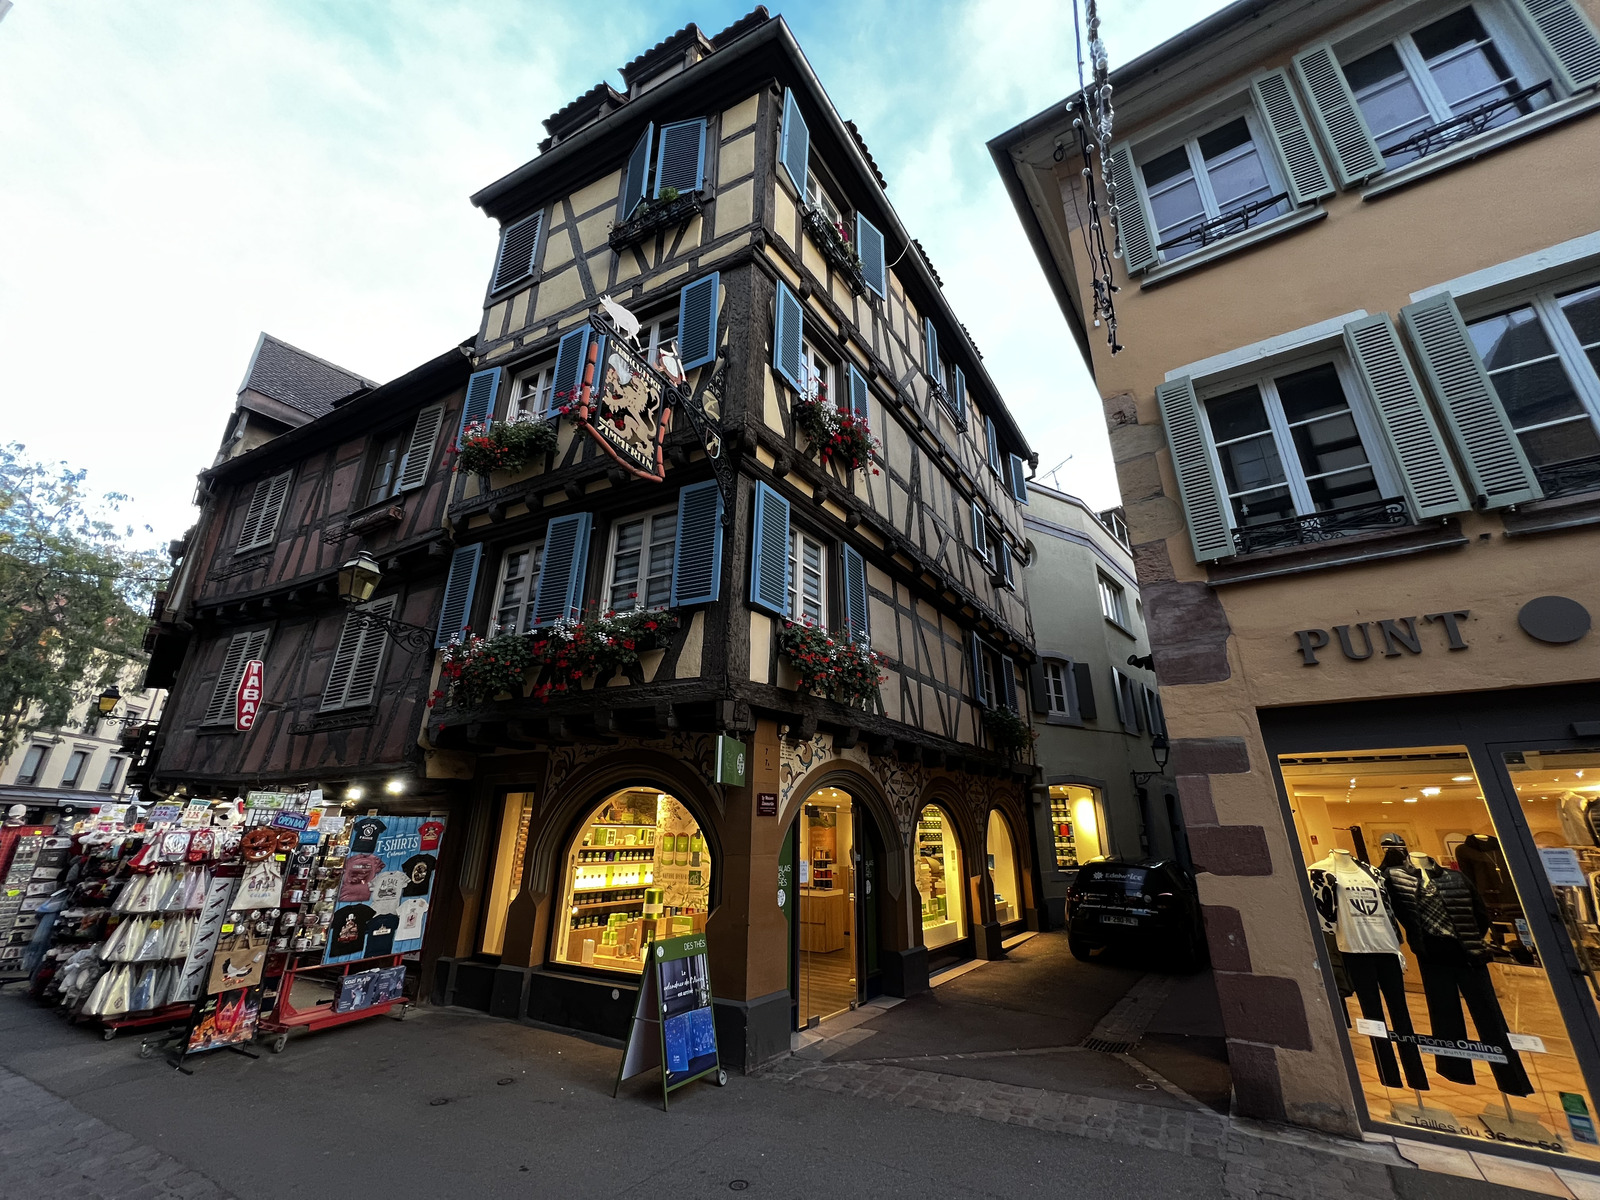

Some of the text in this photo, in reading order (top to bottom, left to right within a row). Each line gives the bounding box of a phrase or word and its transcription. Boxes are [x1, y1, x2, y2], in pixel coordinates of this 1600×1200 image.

[1294, 609, 1471, 667] PUNT
[239, 662, 262, 727] TABAC
[278, 816, 306, 829] OPEN BAR
[376, 837, 420, 853] T-SHIRTS
[683, 941, 694, 951] DES
[1388, 1031, 1418, 1044] Punt
[1418, 1035, 1455, 1048] Roma
[1456, 1039, 1503, 1054] Online
[1420, 1046, 1508, 1062] www.puntroma.com
[1411, 1115, 1456, 1133] Tailles
[1460, 1125, 1480, 1137] du
[1484, 1129, 1507, 1142] 36
